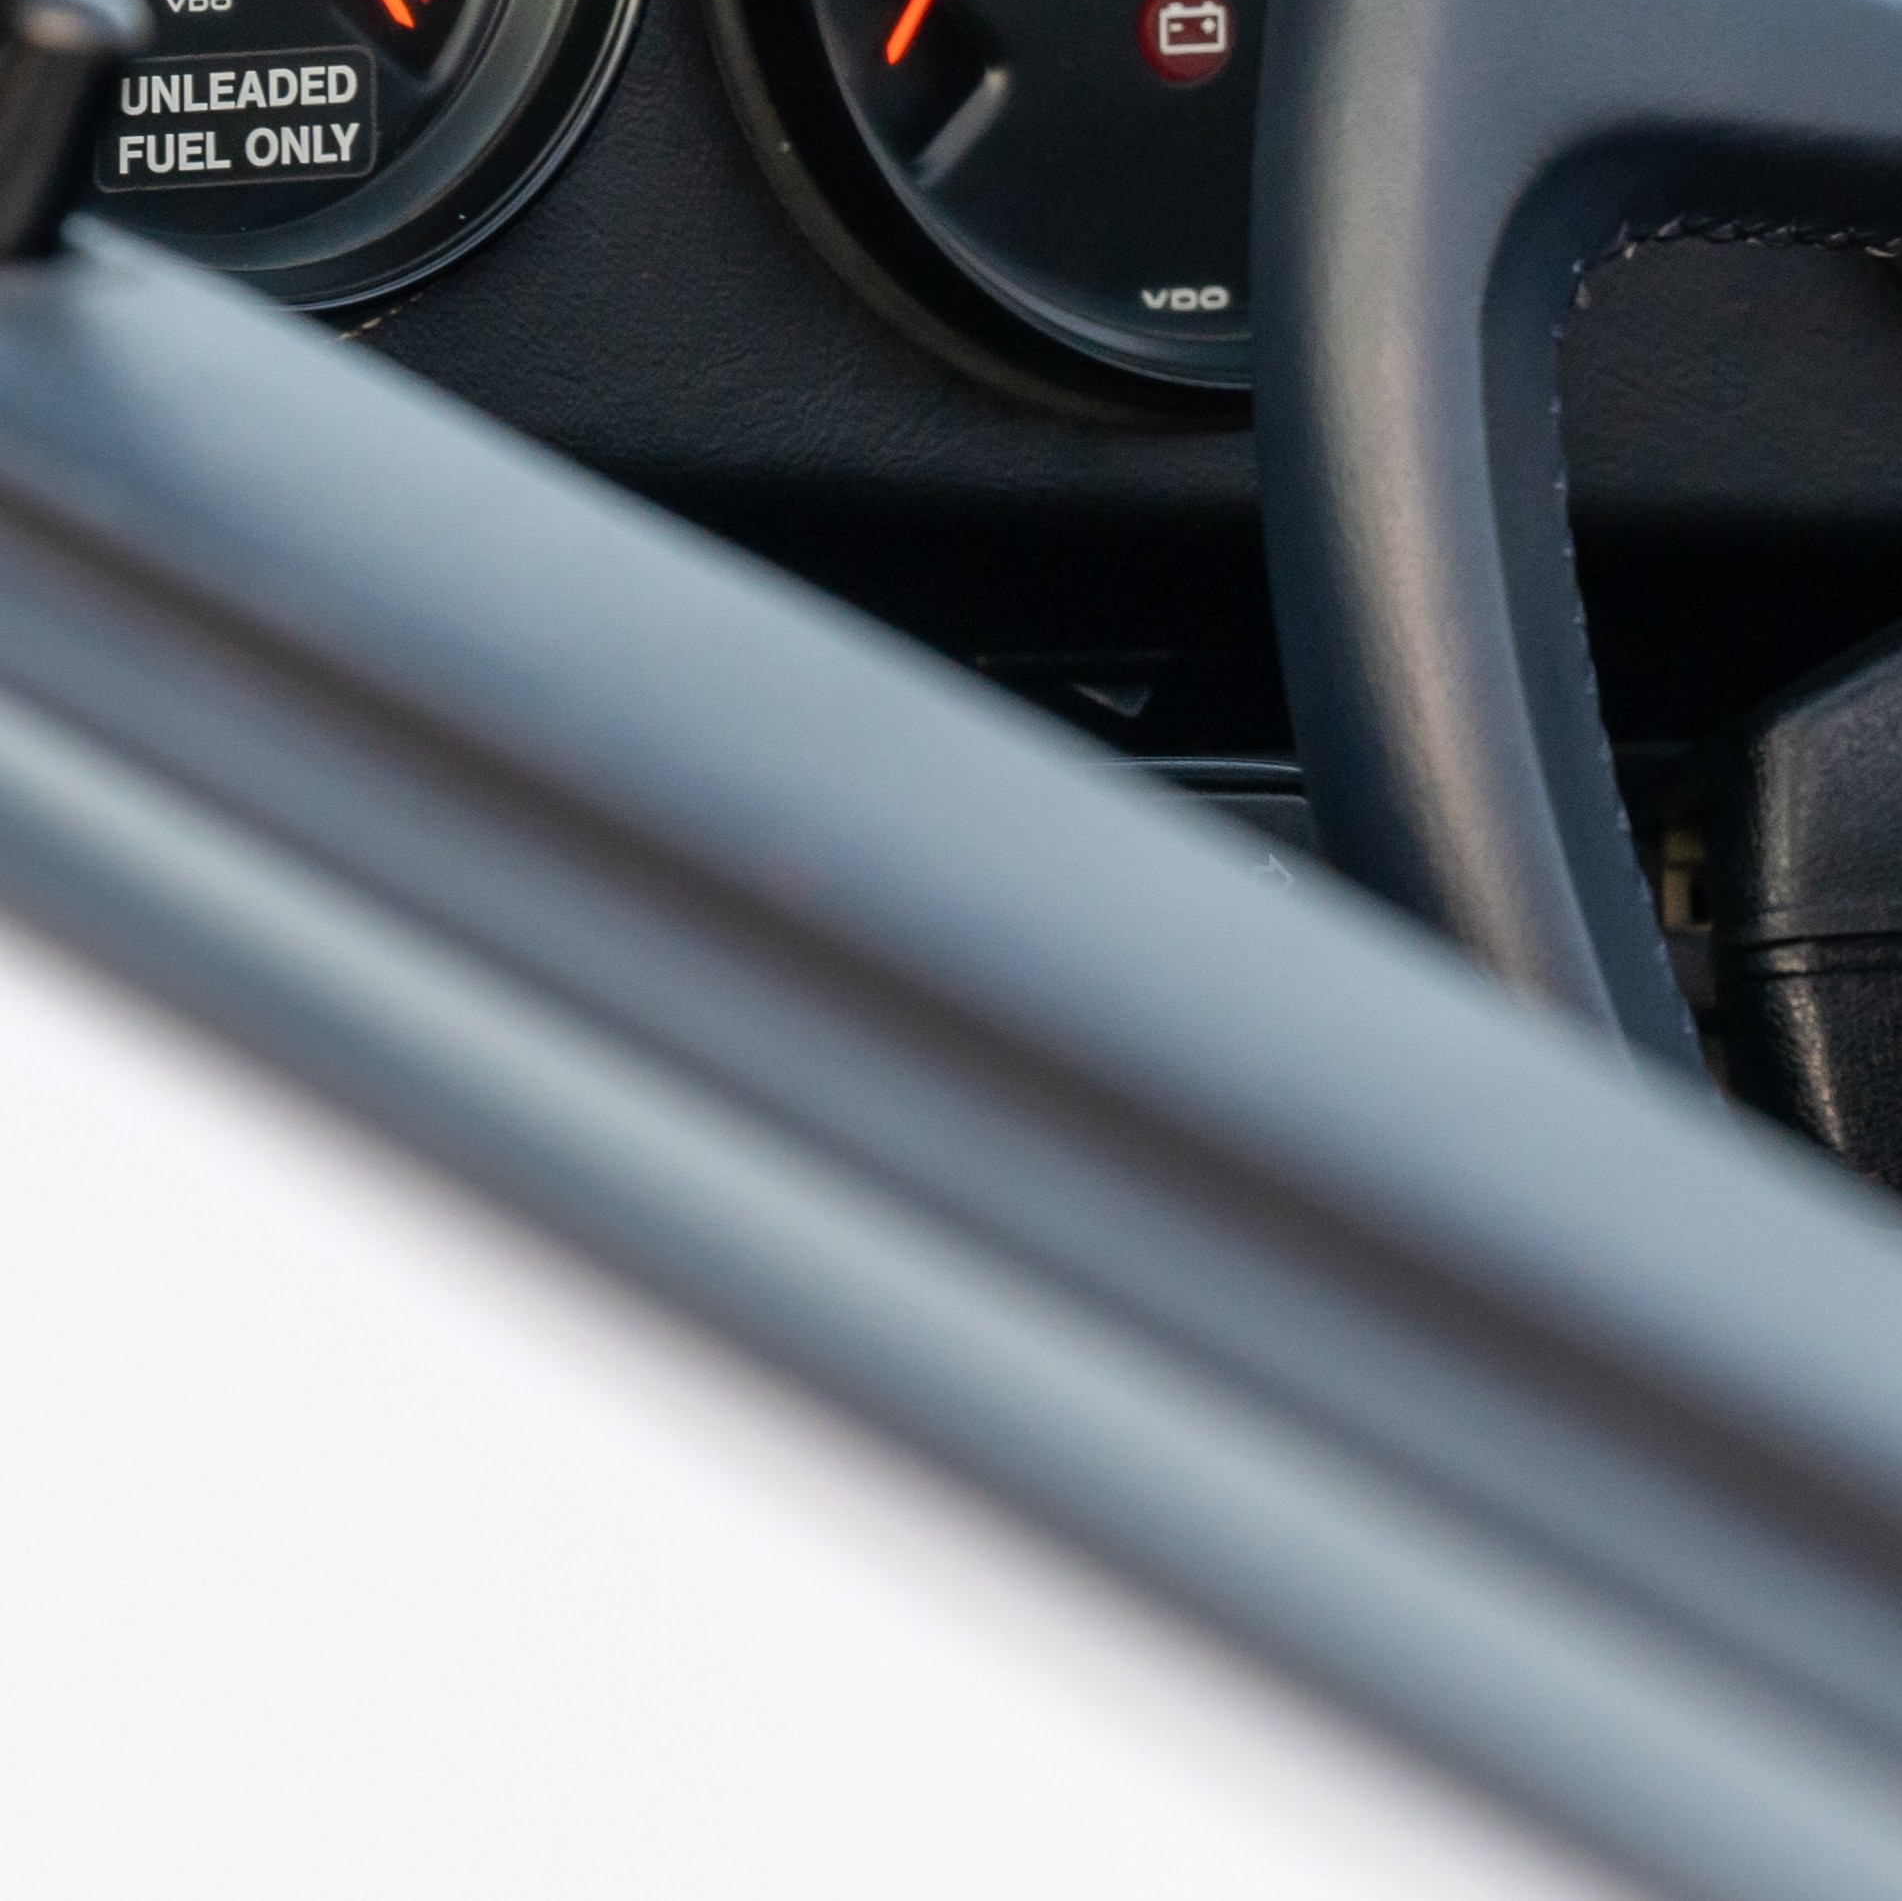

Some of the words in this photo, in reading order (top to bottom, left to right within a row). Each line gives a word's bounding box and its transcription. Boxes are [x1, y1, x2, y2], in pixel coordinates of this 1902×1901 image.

[122, 65, 357, 115] UNLEADED
[119, 131, 231, 175] FUEL
[245, 123, 359, 167] ONLY
[1142, 286, 1229, 311] VDO
